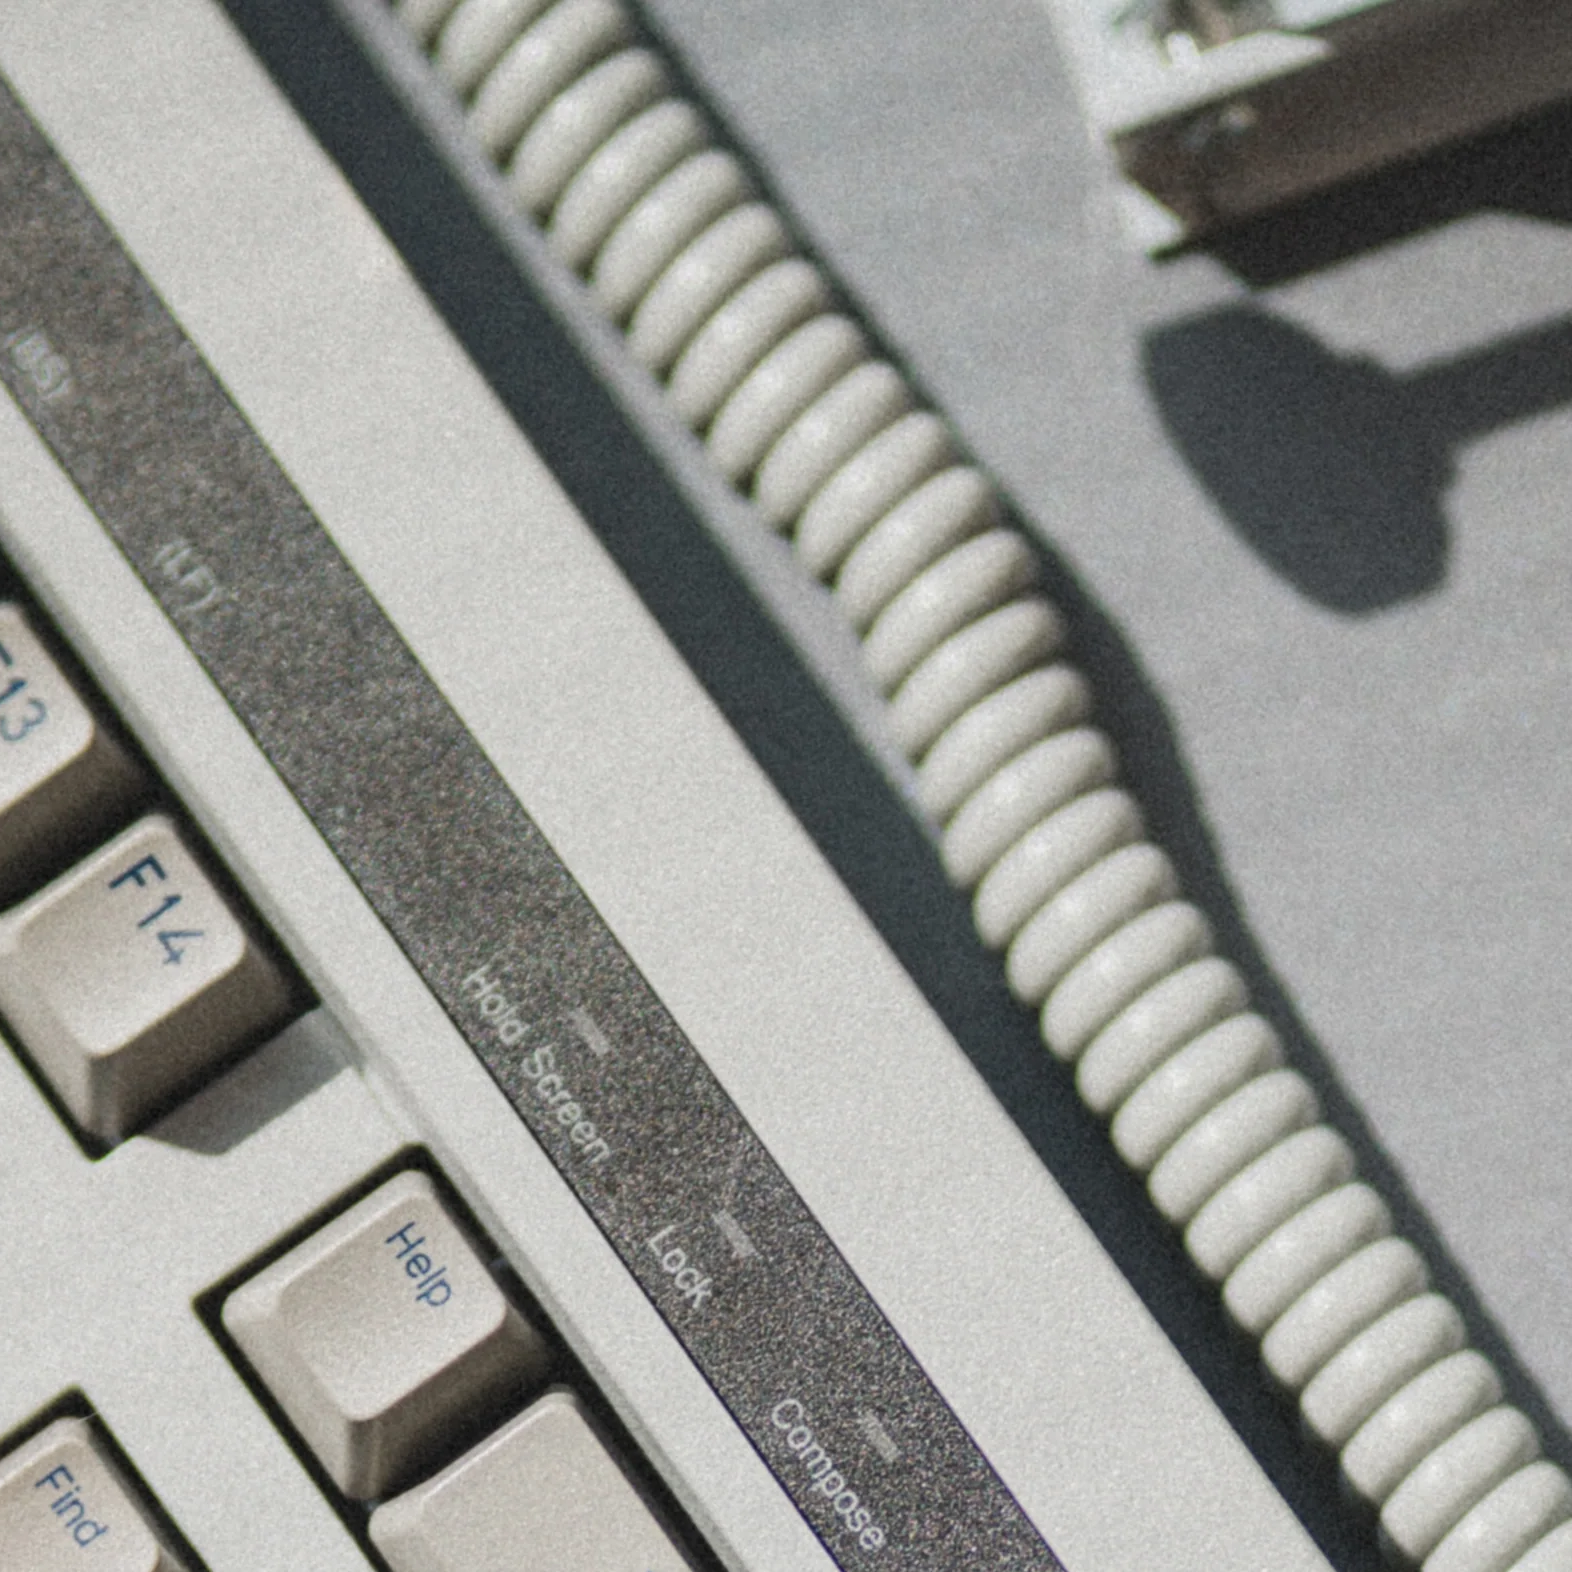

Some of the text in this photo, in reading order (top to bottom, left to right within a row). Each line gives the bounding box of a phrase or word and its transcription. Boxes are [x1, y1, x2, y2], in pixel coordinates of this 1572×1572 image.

[108, 854, 204, 966] F14
[460, 964, 610, 1166] Hold Screen
[384, 1221, 453, 1310] Help
[648, 1224, 715, 1310] Lock
[35, 1464, 109, 1550] Find
[770, 1400, 888, 1553] Compose
